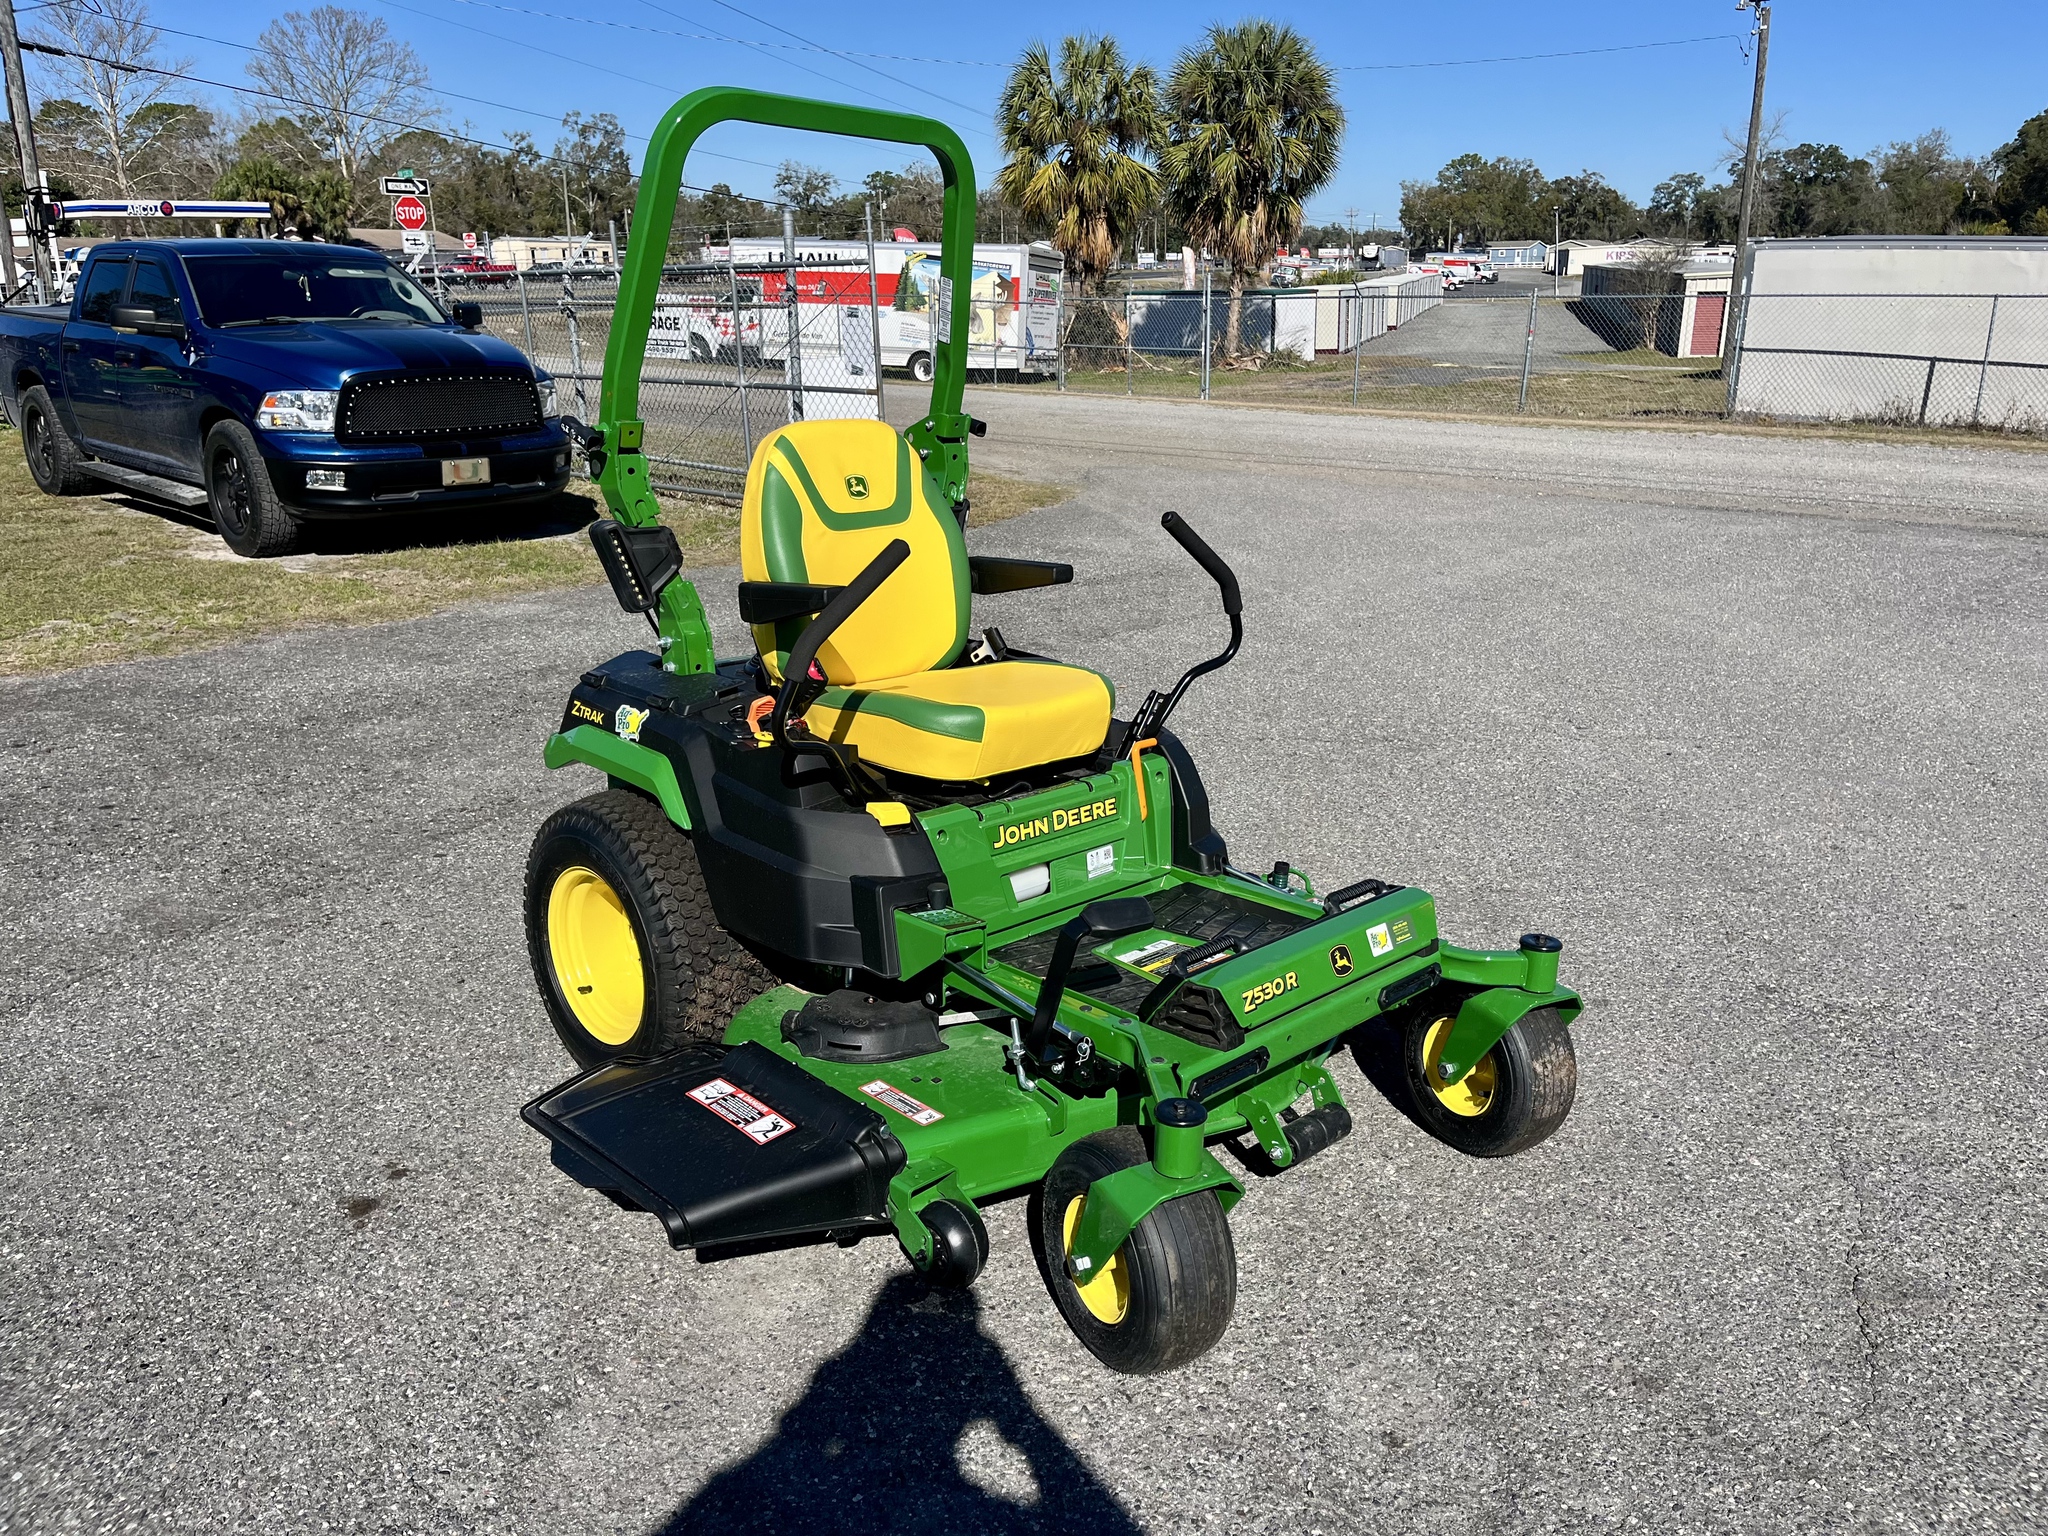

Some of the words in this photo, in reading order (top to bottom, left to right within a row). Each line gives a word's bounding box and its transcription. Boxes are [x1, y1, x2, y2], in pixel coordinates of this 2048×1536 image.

[126, 204, 156, 216] ARCO
[397, 206, 424, 220] STOP
[571, 700, 605, 725] ZTRAK
[617, 718, 631, 730] Pro
[993, 816, 1050, 849] JOHN
[1051, 797, 1118, 832] DEERE
[1241, 978, 1286, 1014] Z530
[1285, 970, 1300, 991] R
